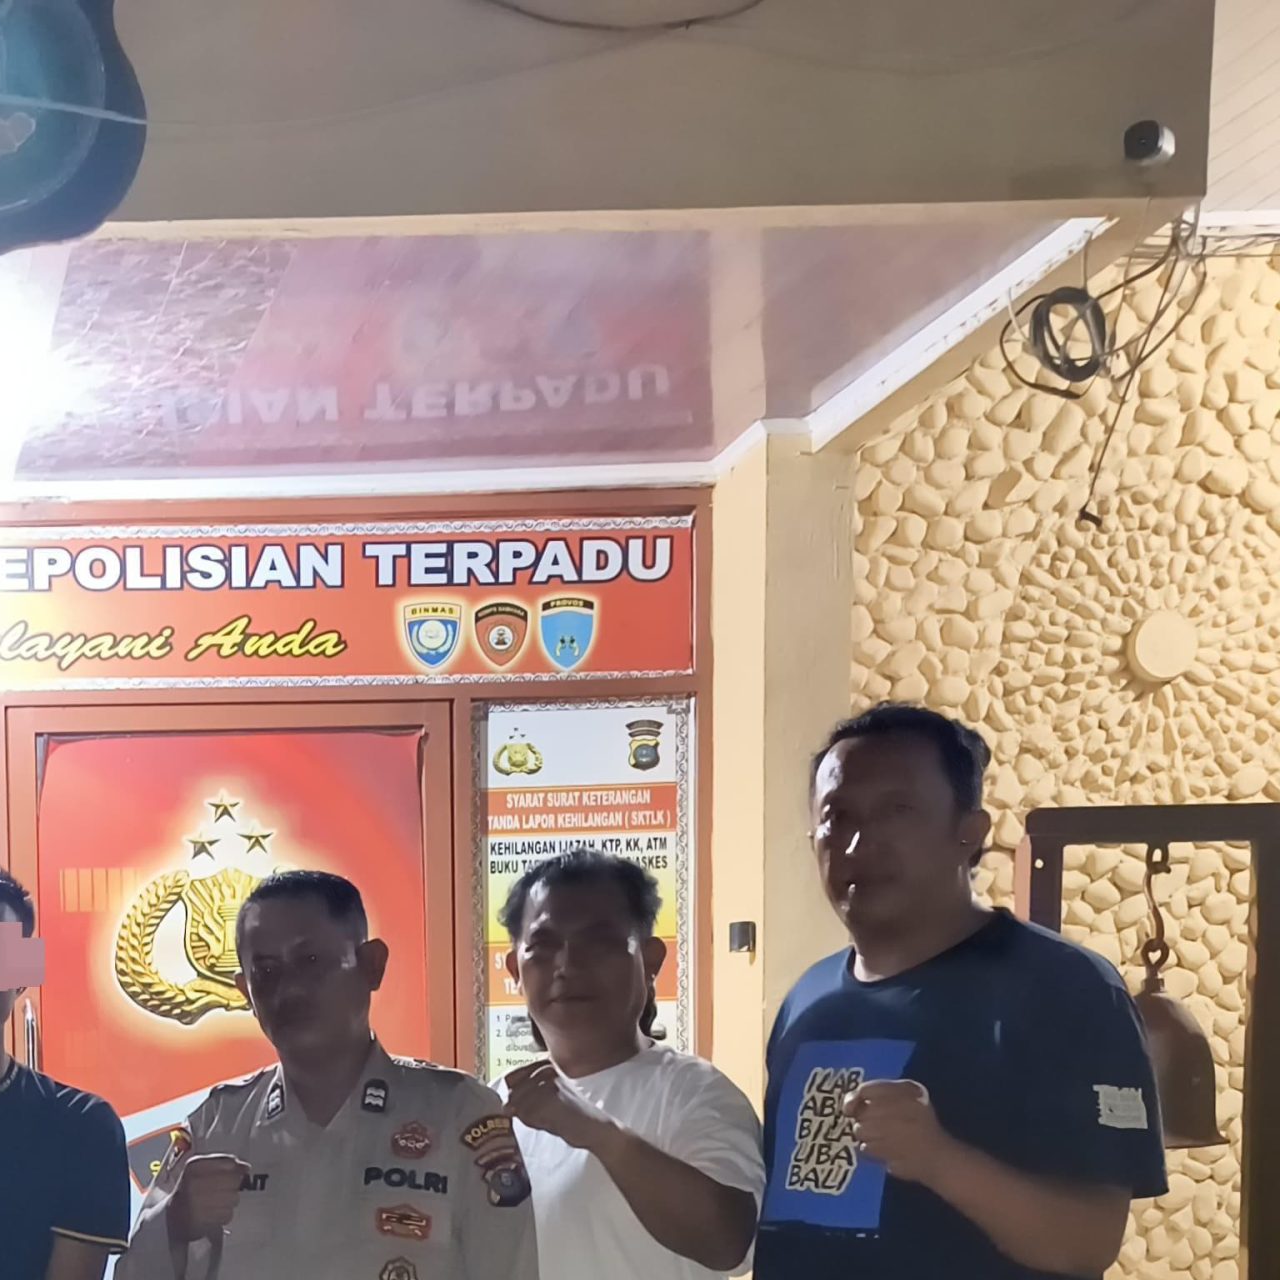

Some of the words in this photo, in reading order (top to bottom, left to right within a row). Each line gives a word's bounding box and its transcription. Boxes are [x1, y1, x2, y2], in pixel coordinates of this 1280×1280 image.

[363, 536, 672, 587] TERPADU
[411, 606, 455, 616] BINMAS
[188, 614, 347, 662] Anda
[506, 791, 545, 809] SYARAT
[547, 790, 580, 808] SURAT
[582, 788, 651, 807] KETERANGAN
[488, 815, 520, 832] TANDA
[522, 813, 556, 830] LAPOR
[558, 811, 622, 829] KEHILANGAN
[631, 810, 664, 827] SKTLK
[490, 840, 556, 856] KEHILANGAN
[646, 836, 668, 851] ATM
[490, 859, 519, 875] BUKU
[798, 1117, 856, 1142] BILA
[793, 1142, 854, 1167] LIBA
[363, 1166, 448, 1194] POLRI
[788, 1163, 850, 1192] BALI
